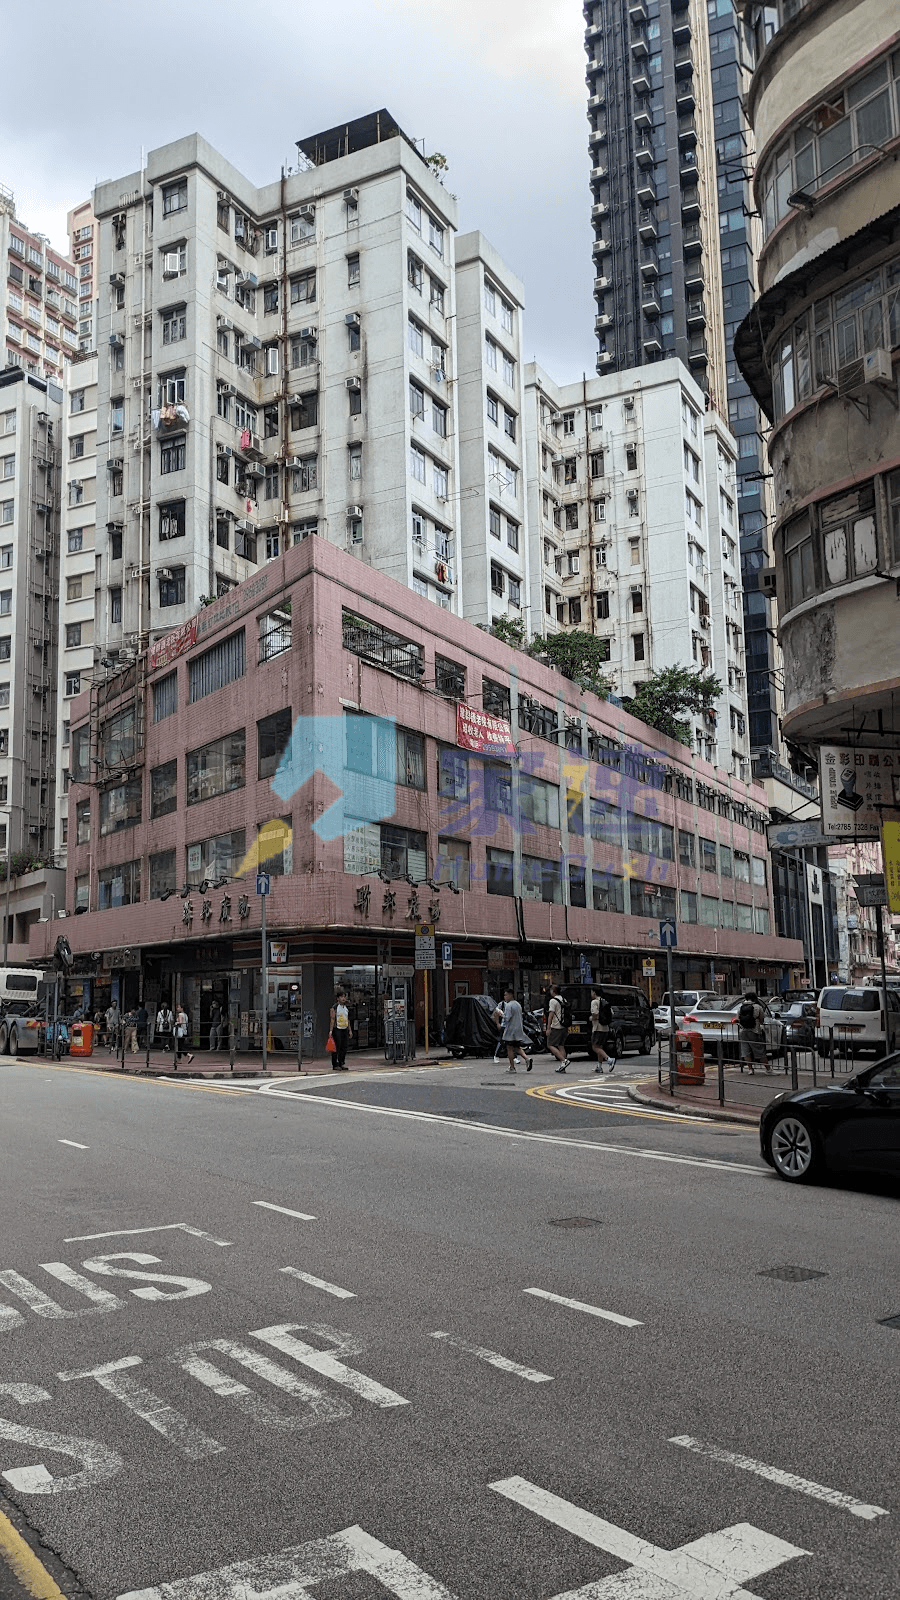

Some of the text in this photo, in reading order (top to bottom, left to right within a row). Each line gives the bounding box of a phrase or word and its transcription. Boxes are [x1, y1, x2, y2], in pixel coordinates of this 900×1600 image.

[824, 751, 900, 767] 金彩印刷公
[444, 945, 451, 960] P
[0, 1252, 212, 1332] US
